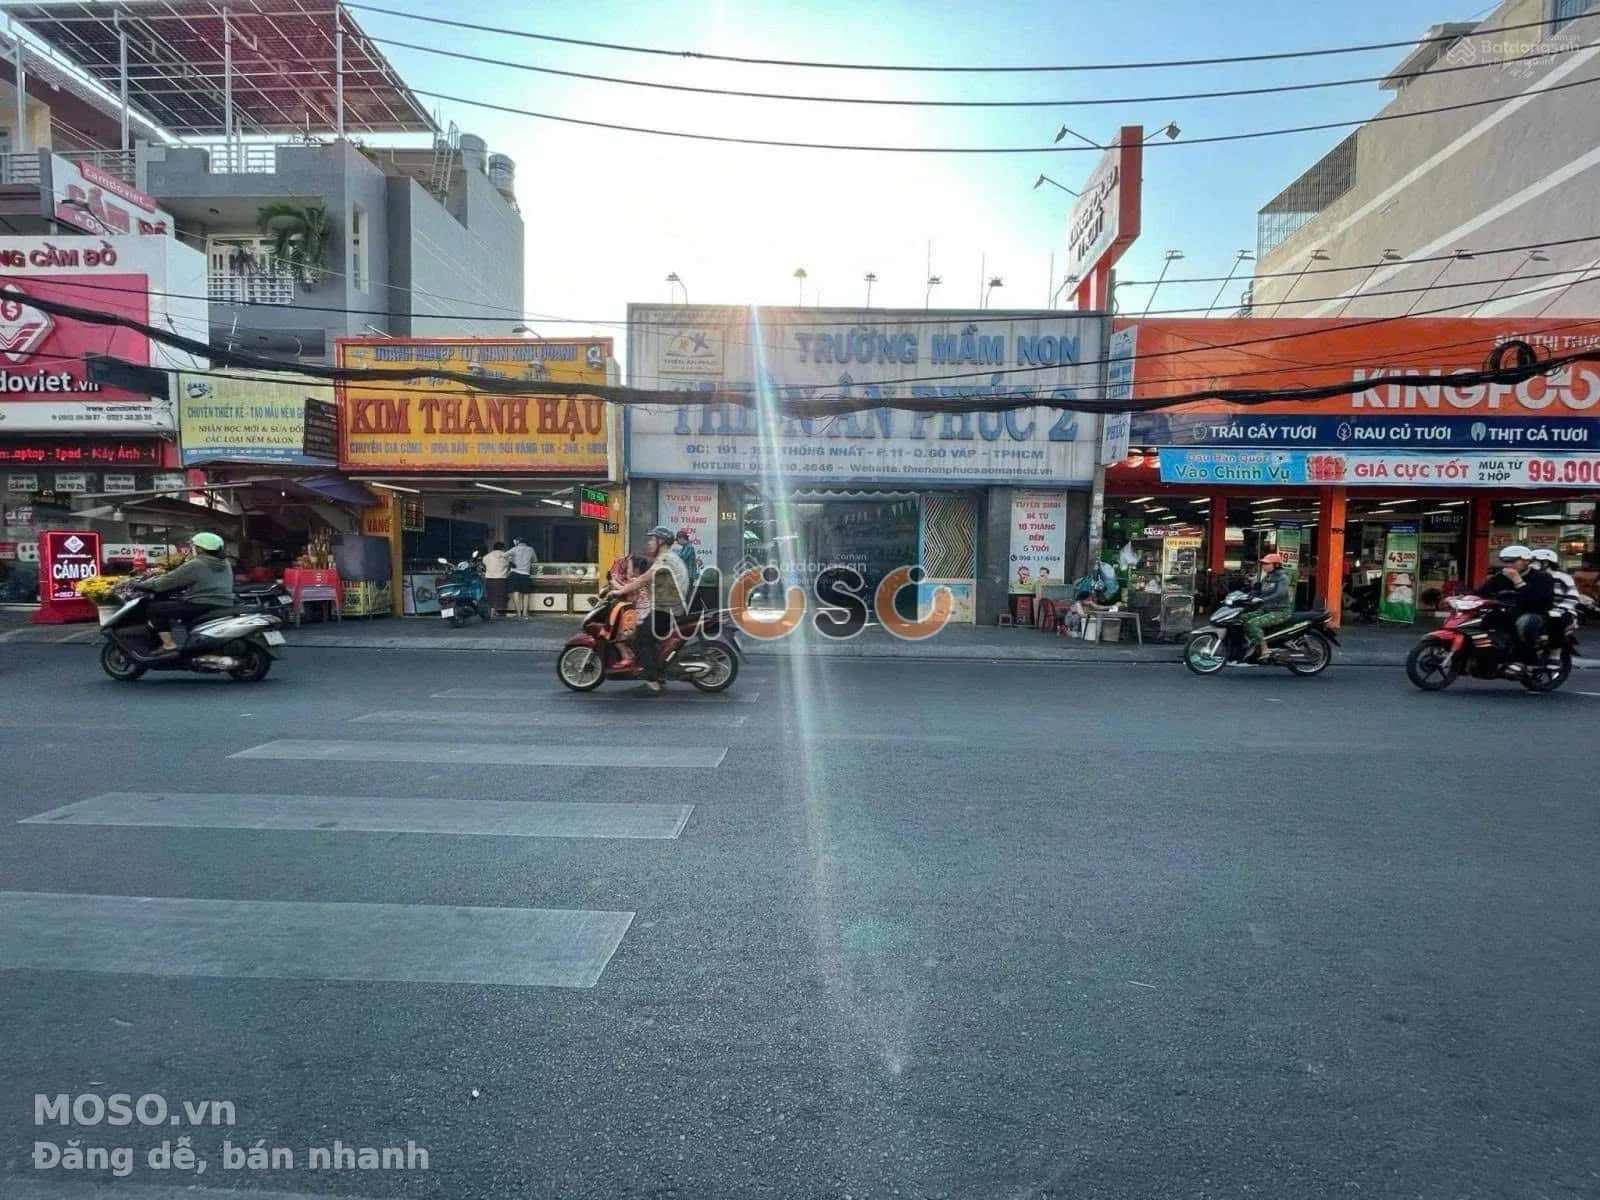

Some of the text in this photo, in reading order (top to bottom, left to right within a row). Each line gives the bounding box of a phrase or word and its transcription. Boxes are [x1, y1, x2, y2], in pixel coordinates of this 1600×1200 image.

[796, 323, 1081, 366] TRƯỜNG MẦM NON
[350, 397, 411, 434] KIM
[1210, 422, 1317, 440] TRÁI CÂY TƯƠI
[1354, 423, 1452, 440] RAU CỦ TƯƠI
[1488, 424, 1588, 444] THỊT CÁ TƯƠI
[993, 449, 1045, 460] TPHCM
[1175, 462, 1290, 483] Vào Chính Vụ
[1354, 458, 1469, 481] GIÁ CỰC TỐT
[1478, 460, 1524, 470] MUA TỪ
[1478, 473, 1485, 481] 2
